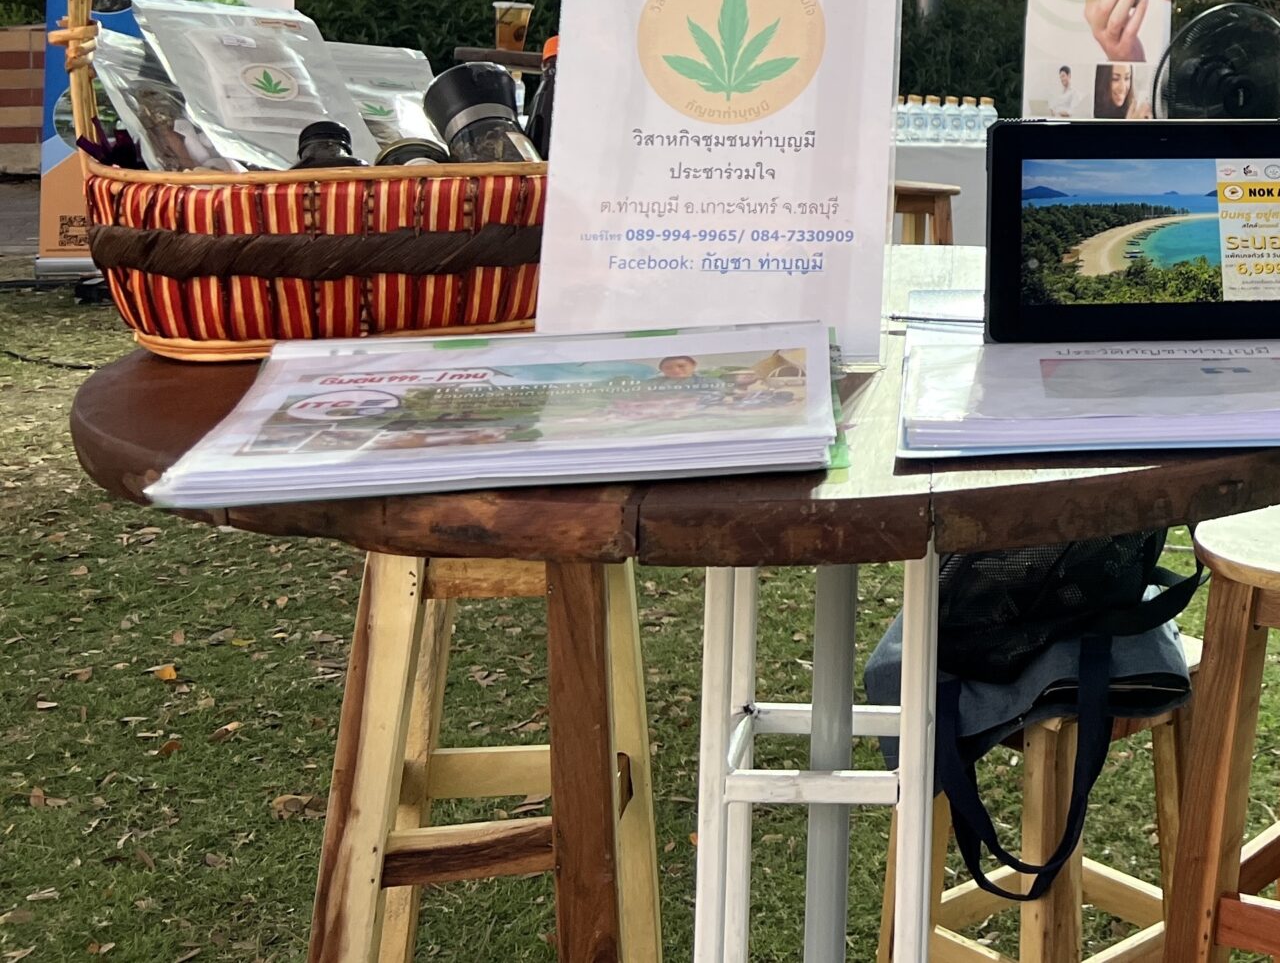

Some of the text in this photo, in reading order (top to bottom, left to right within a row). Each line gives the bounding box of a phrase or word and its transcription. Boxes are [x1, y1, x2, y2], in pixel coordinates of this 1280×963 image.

[632, 128, 817, 153] วิสาหกิจชุมชนท่าบุญมี
[669, 161, 776, 181] ประชาร่วมใจ
[1248, 188, 1274, 197] NOK
[599, 195, 839, 220] ต.ท่าบุญมี อ.เกาะจันทร์ จ.ชลบุรี
[625, 228, 746, 244] 089-994-9965/
[750, 229, 855, 243] 084-7330909
[608, 251, 824, 275] Facebook: กัญชา ท่าบุญมี
